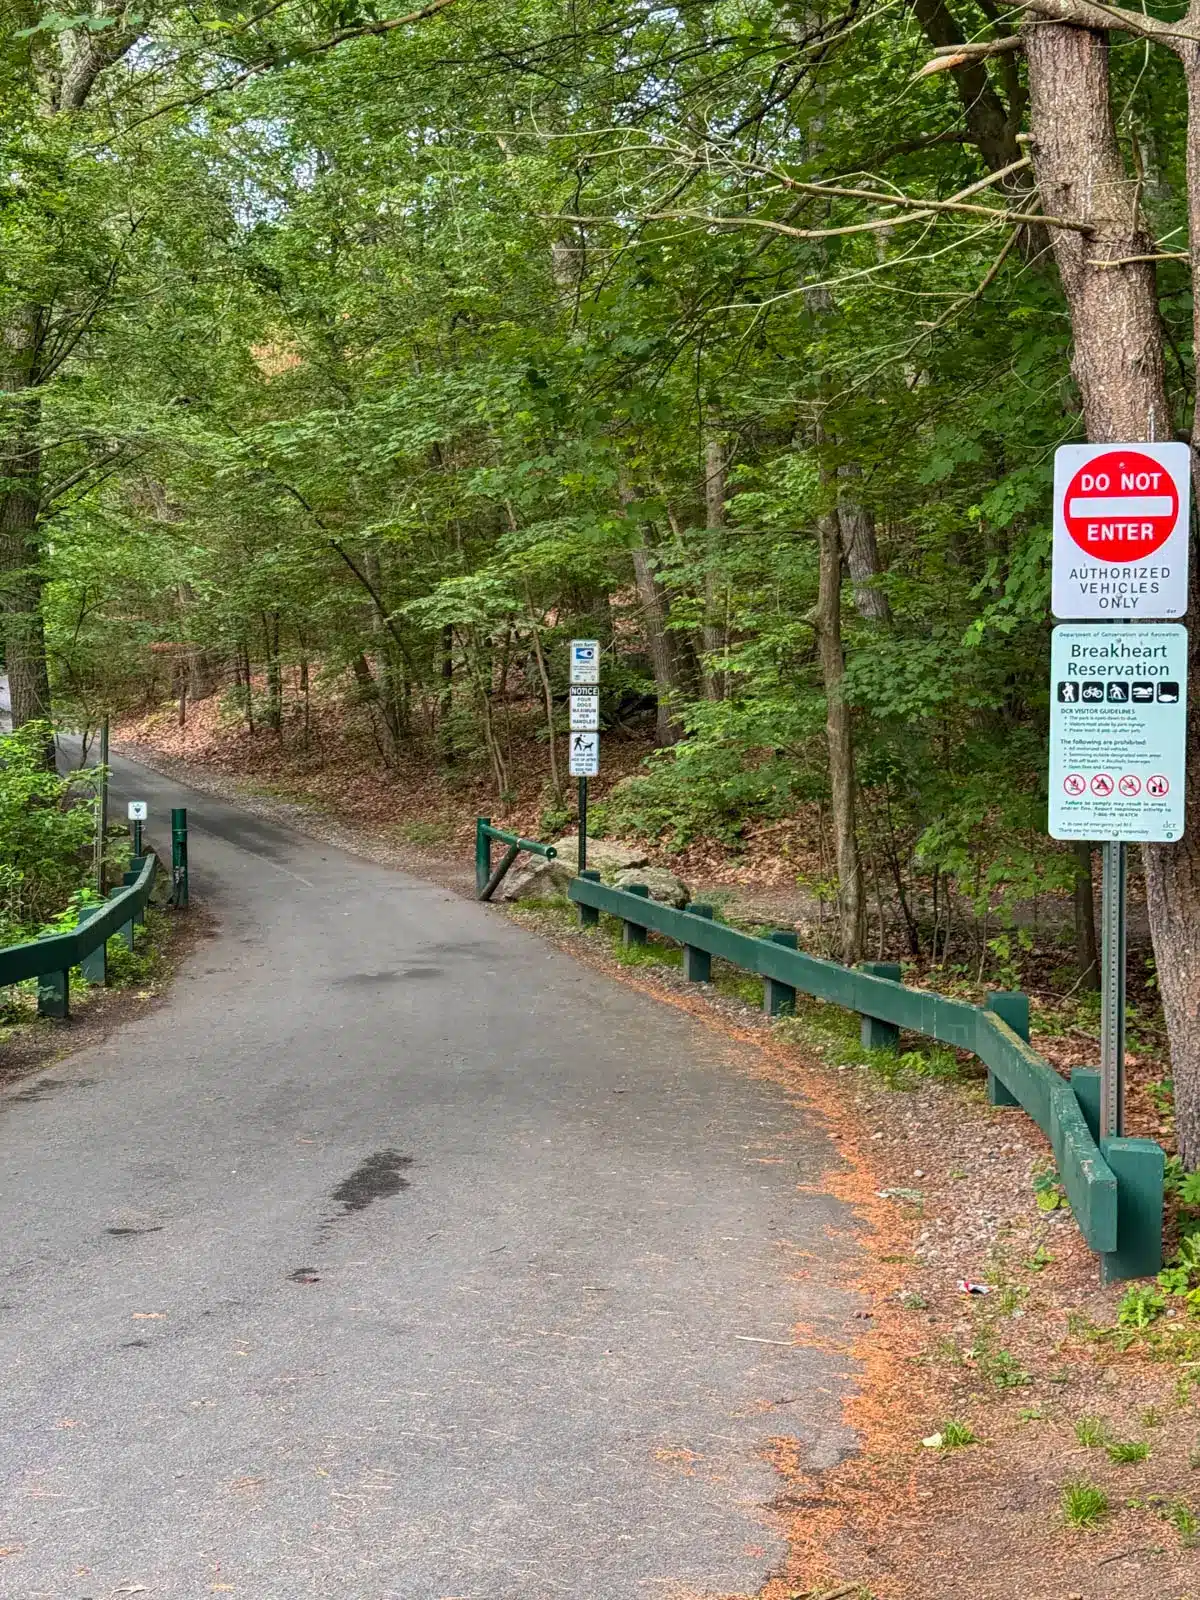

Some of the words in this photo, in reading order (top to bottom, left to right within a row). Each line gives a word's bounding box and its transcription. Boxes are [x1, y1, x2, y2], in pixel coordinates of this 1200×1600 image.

[1081, 474, 1110, 492] DO
[1121, 473, 1161, 490] NOT
[1088, 524, 1153, 541] ENTER
[1070, 568, 1170, 580] AUTHORIZED
[1080, 582, 1159, 594] VEHICLES
[1100, 597, 1139, 608] ONLY
[1071, 643, 1167, 658] Breakheart
[1068, 662, 1169, 676] Reservation
